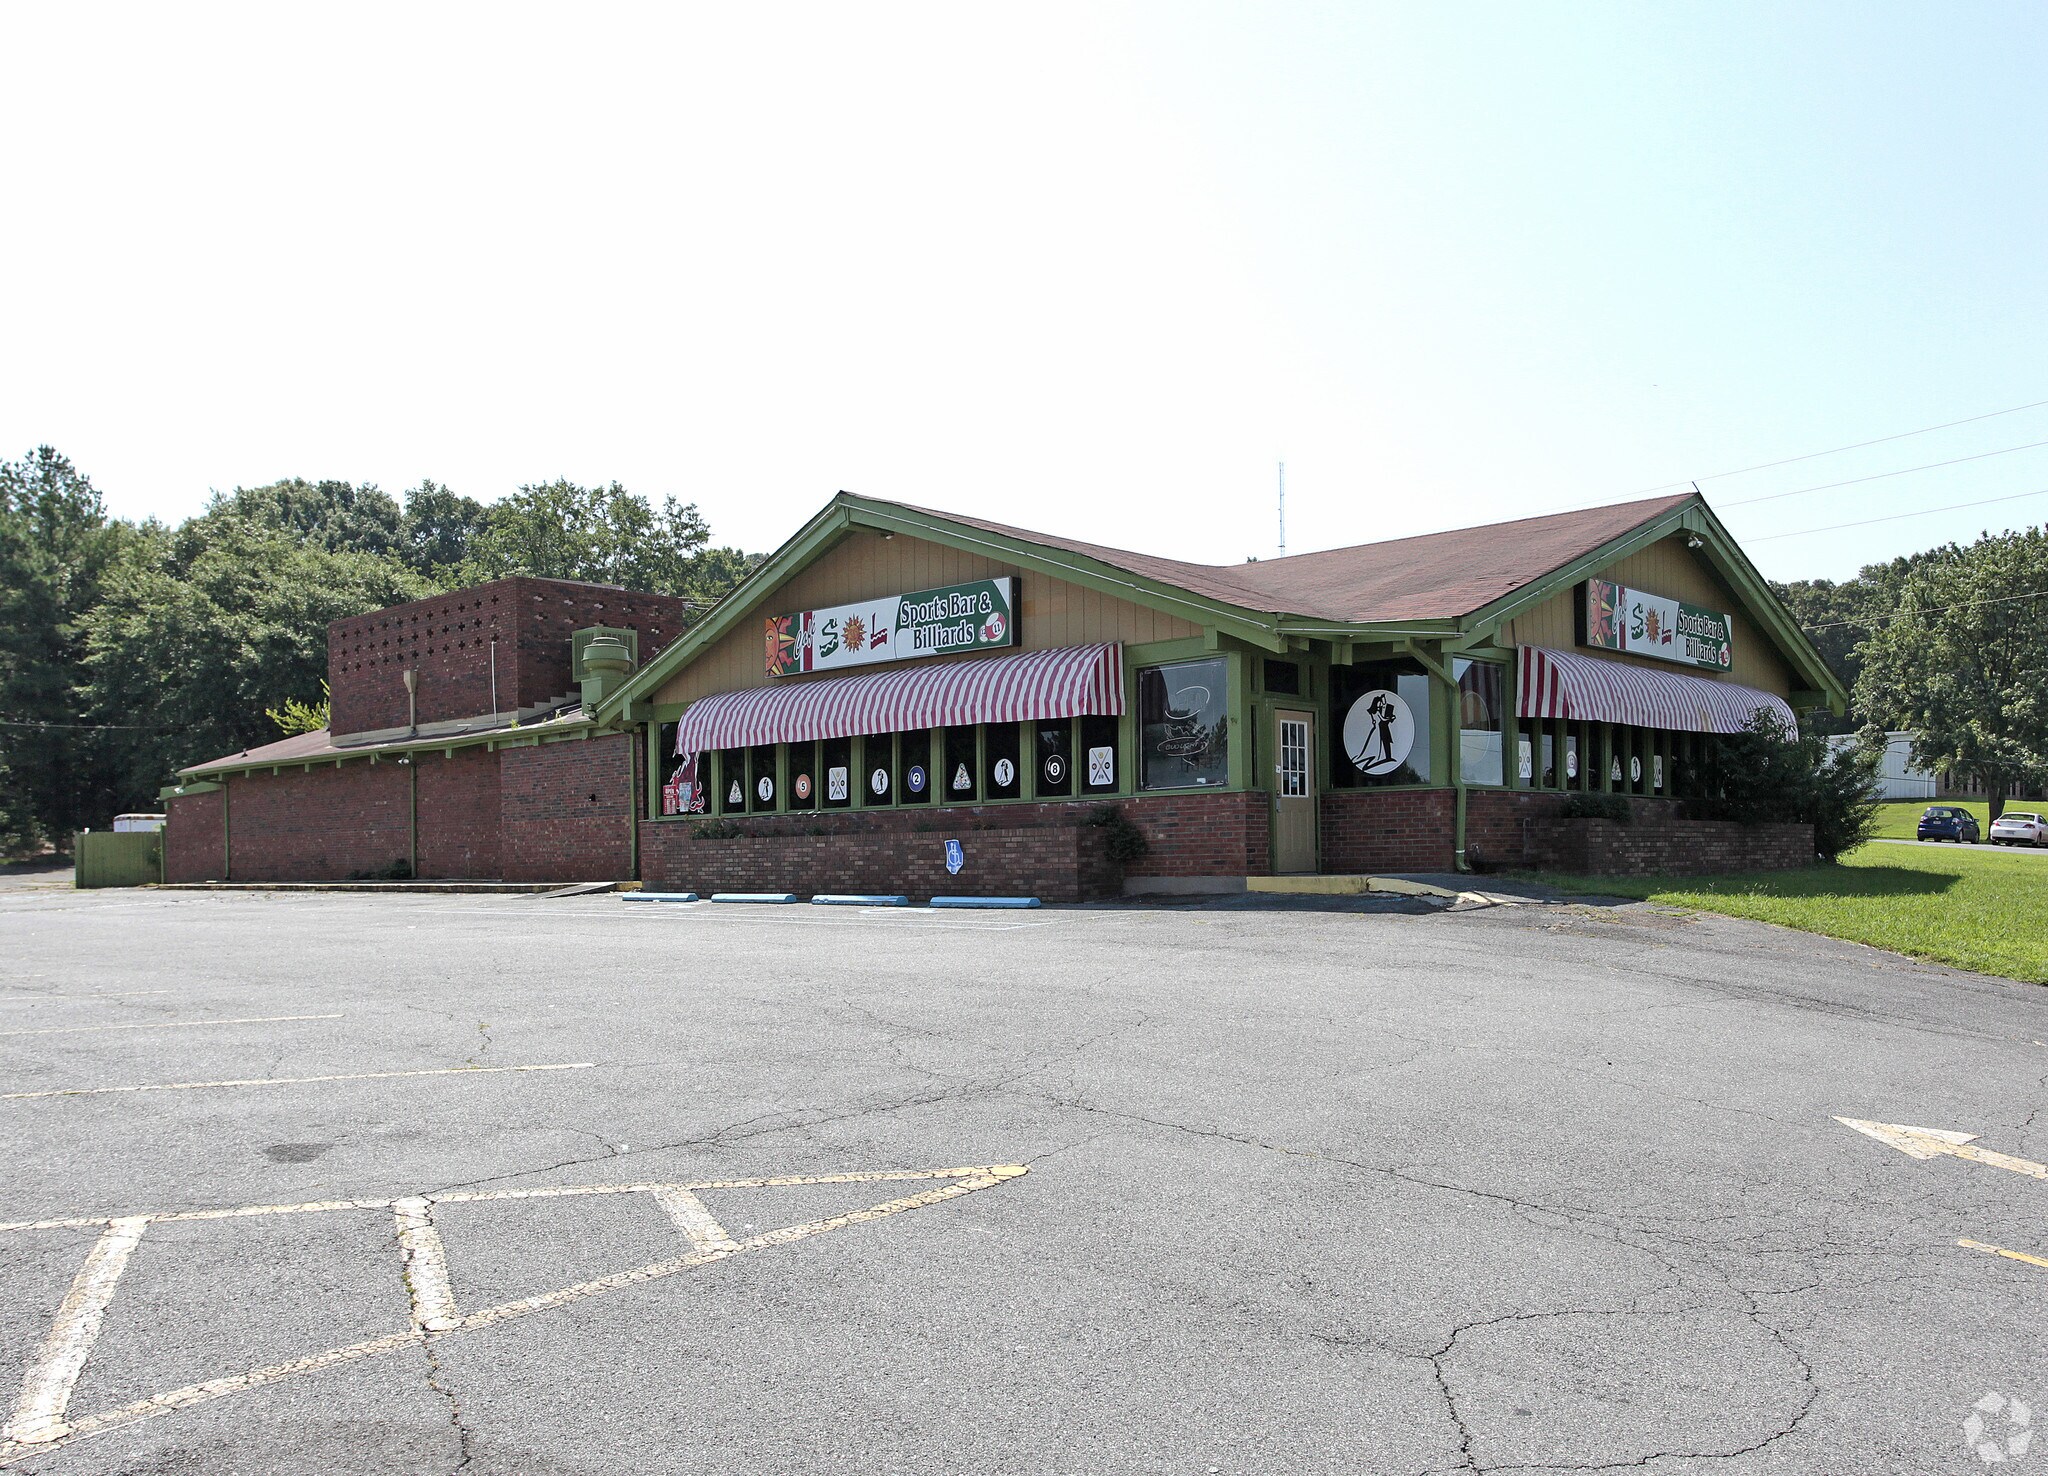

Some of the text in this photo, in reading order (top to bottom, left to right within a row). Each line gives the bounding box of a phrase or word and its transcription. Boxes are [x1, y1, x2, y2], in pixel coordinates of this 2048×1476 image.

[901, 591, 992, 628] Sports Bar &
[994, 623, 1000, 633] 11
[1678, 609, 1725, 641] Sports Bar &
[913, 620, 974, 650] Billiards
[1686, 637, 1716, 663] Billiards
[1052, 764, 1058, 773] 8
[801, 782, 806, 791] 5
[914, 774, 919, 783] 2
